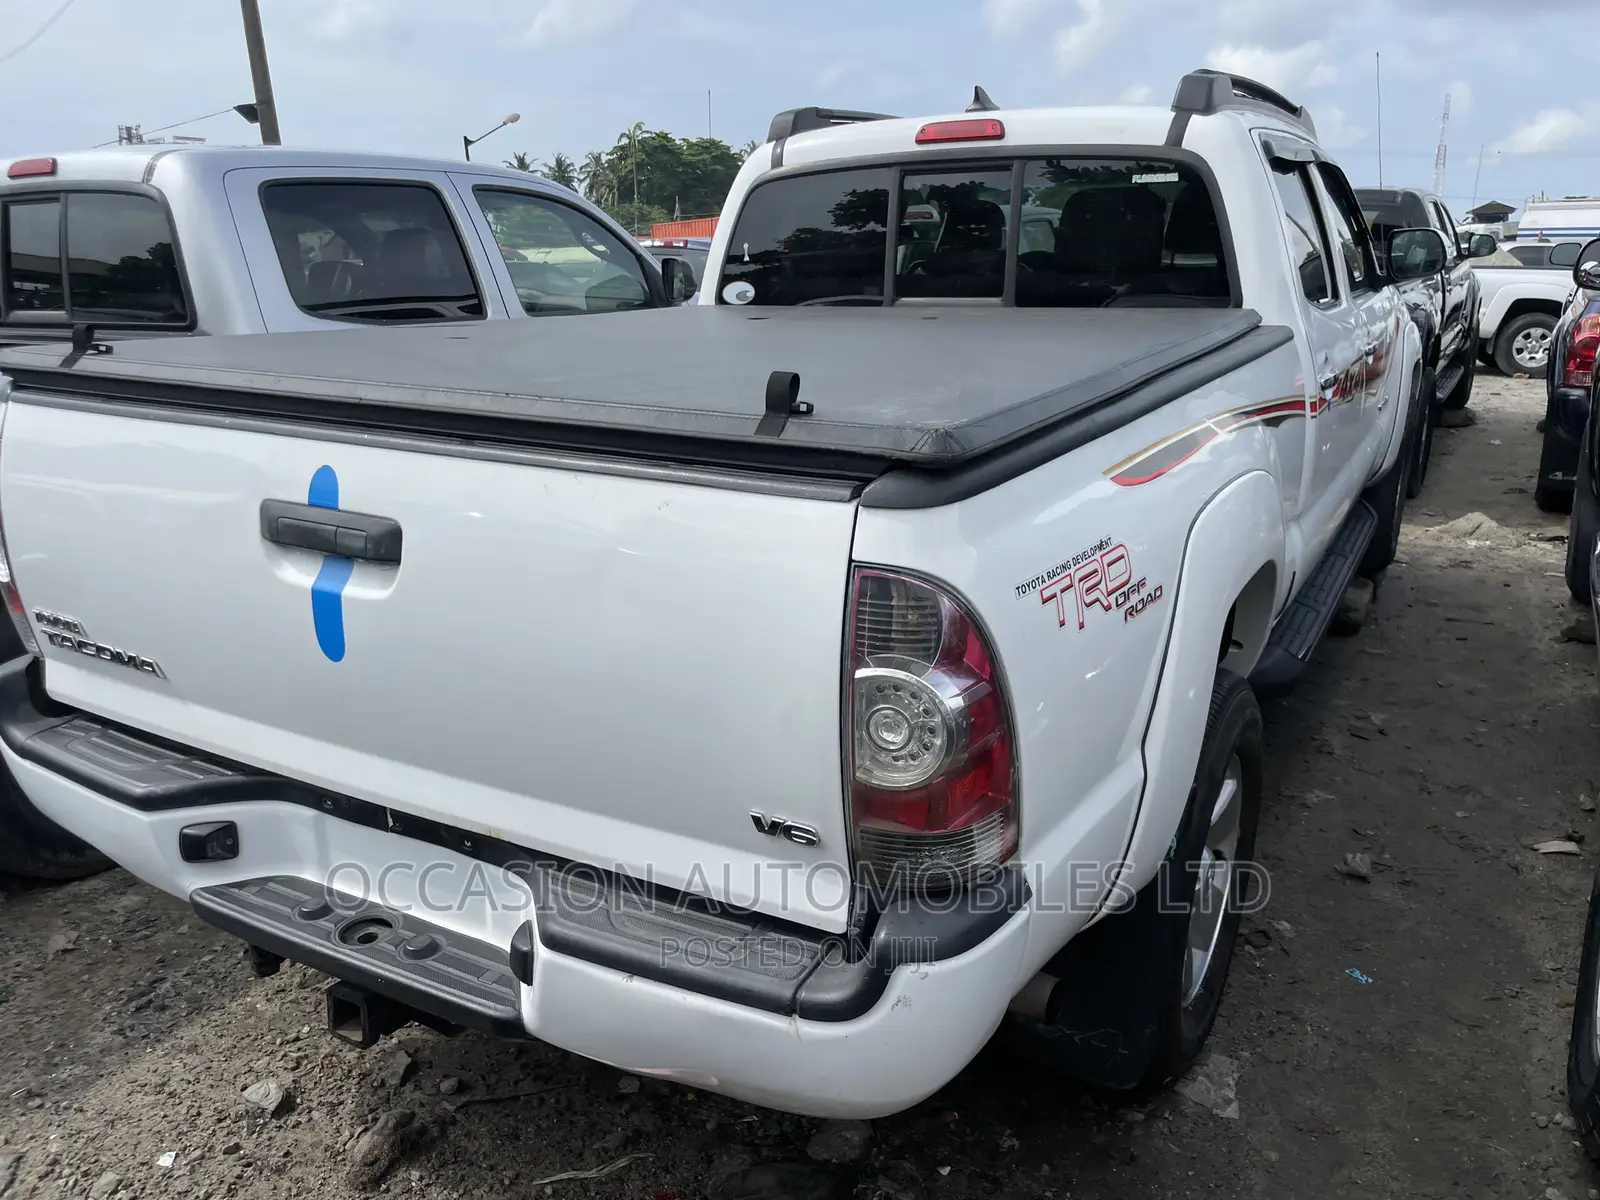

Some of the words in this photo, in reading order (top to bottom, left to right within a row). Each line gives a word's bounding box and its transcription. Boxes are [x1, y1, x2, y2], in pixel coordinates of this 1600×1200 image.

[1015, 574, 1047, 597] TOYOTA
[1046, 560, 1072, 582] RACING
[1072, 537, 1113, 567] DEVELOPMENT
[1040, 543, 1132, 630] TRD
[1115, 577, 1147, 608] OFF
[1124, 584, 1163, 624] ROAD
[40, 627, 168, 680] TACOMA
[749, 809, 820, 848] V6
